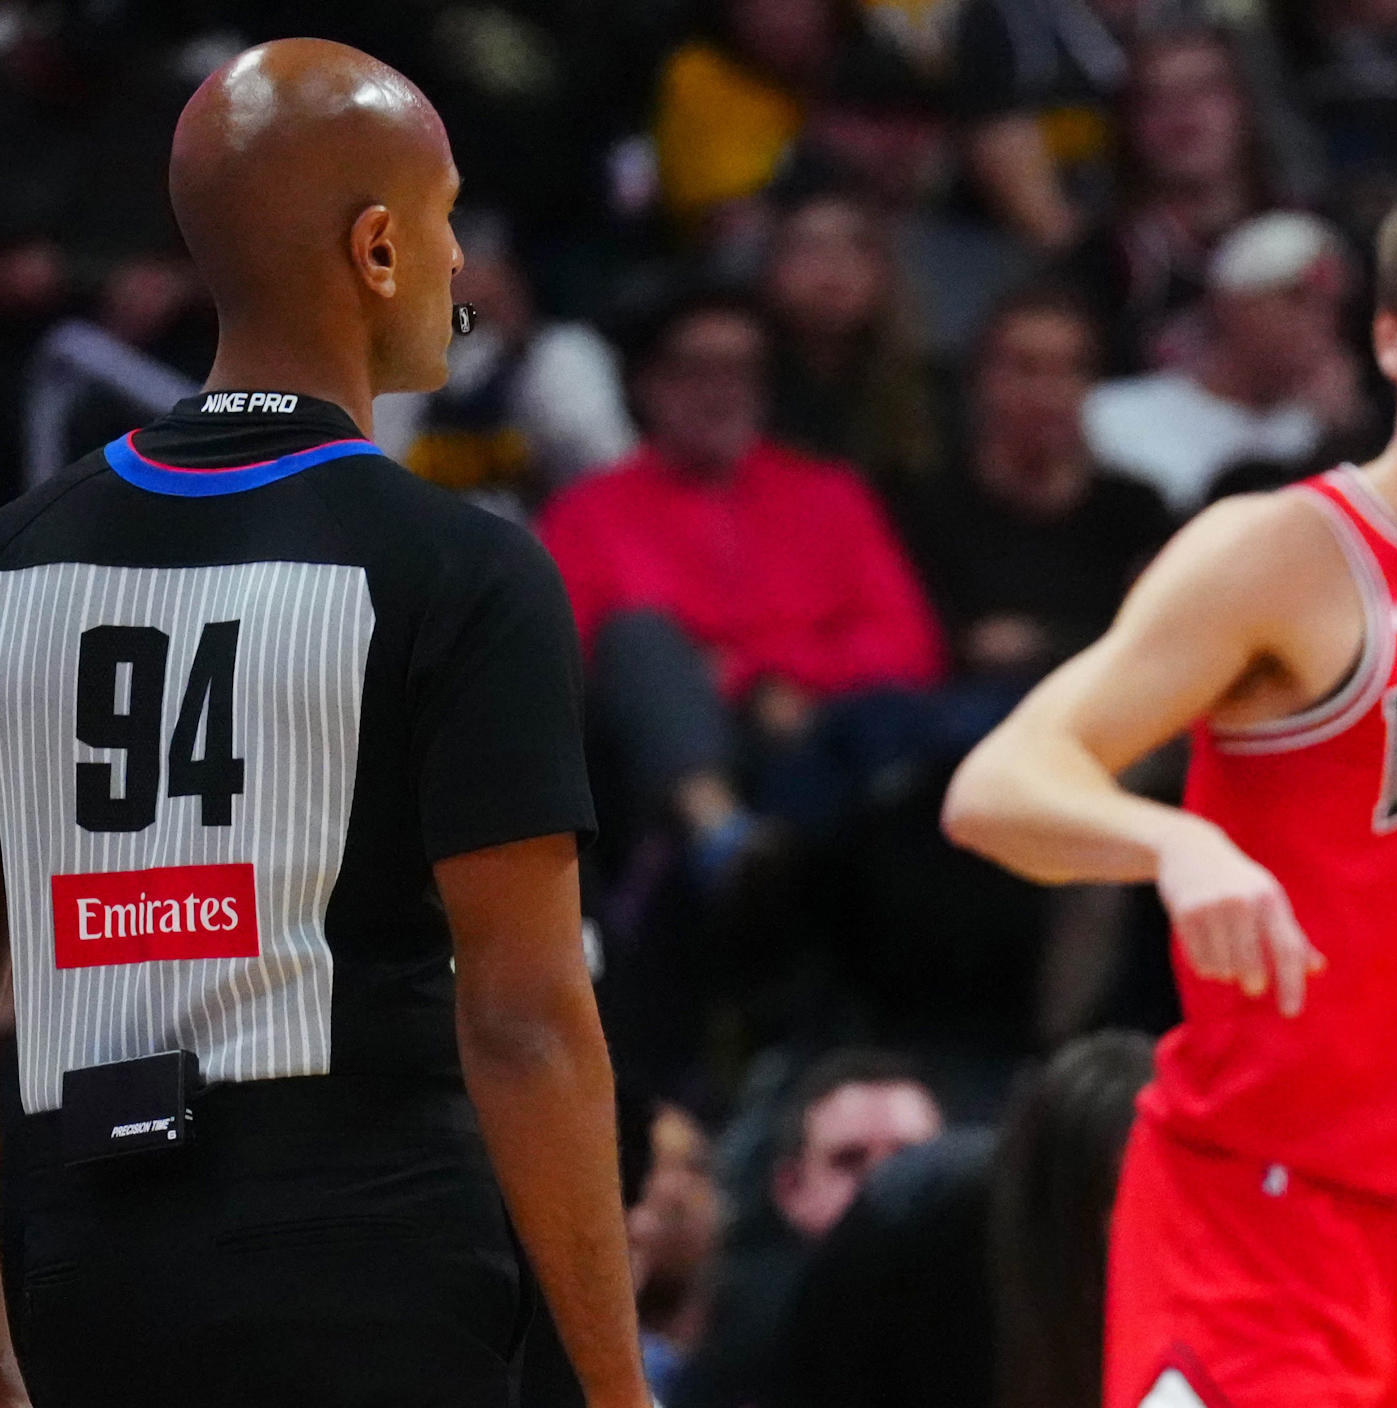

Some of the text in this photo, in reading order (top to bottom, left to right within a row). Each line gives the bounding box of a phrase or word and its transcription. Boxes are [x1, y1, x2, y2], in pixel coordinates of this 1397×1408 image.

[201, 392, 298, 413] NIKE PRO
[75, 618, 245, 833] 94
[76, 890, 239, 942] Emirates
[111, 1120, 152, 1139] PRECISION
